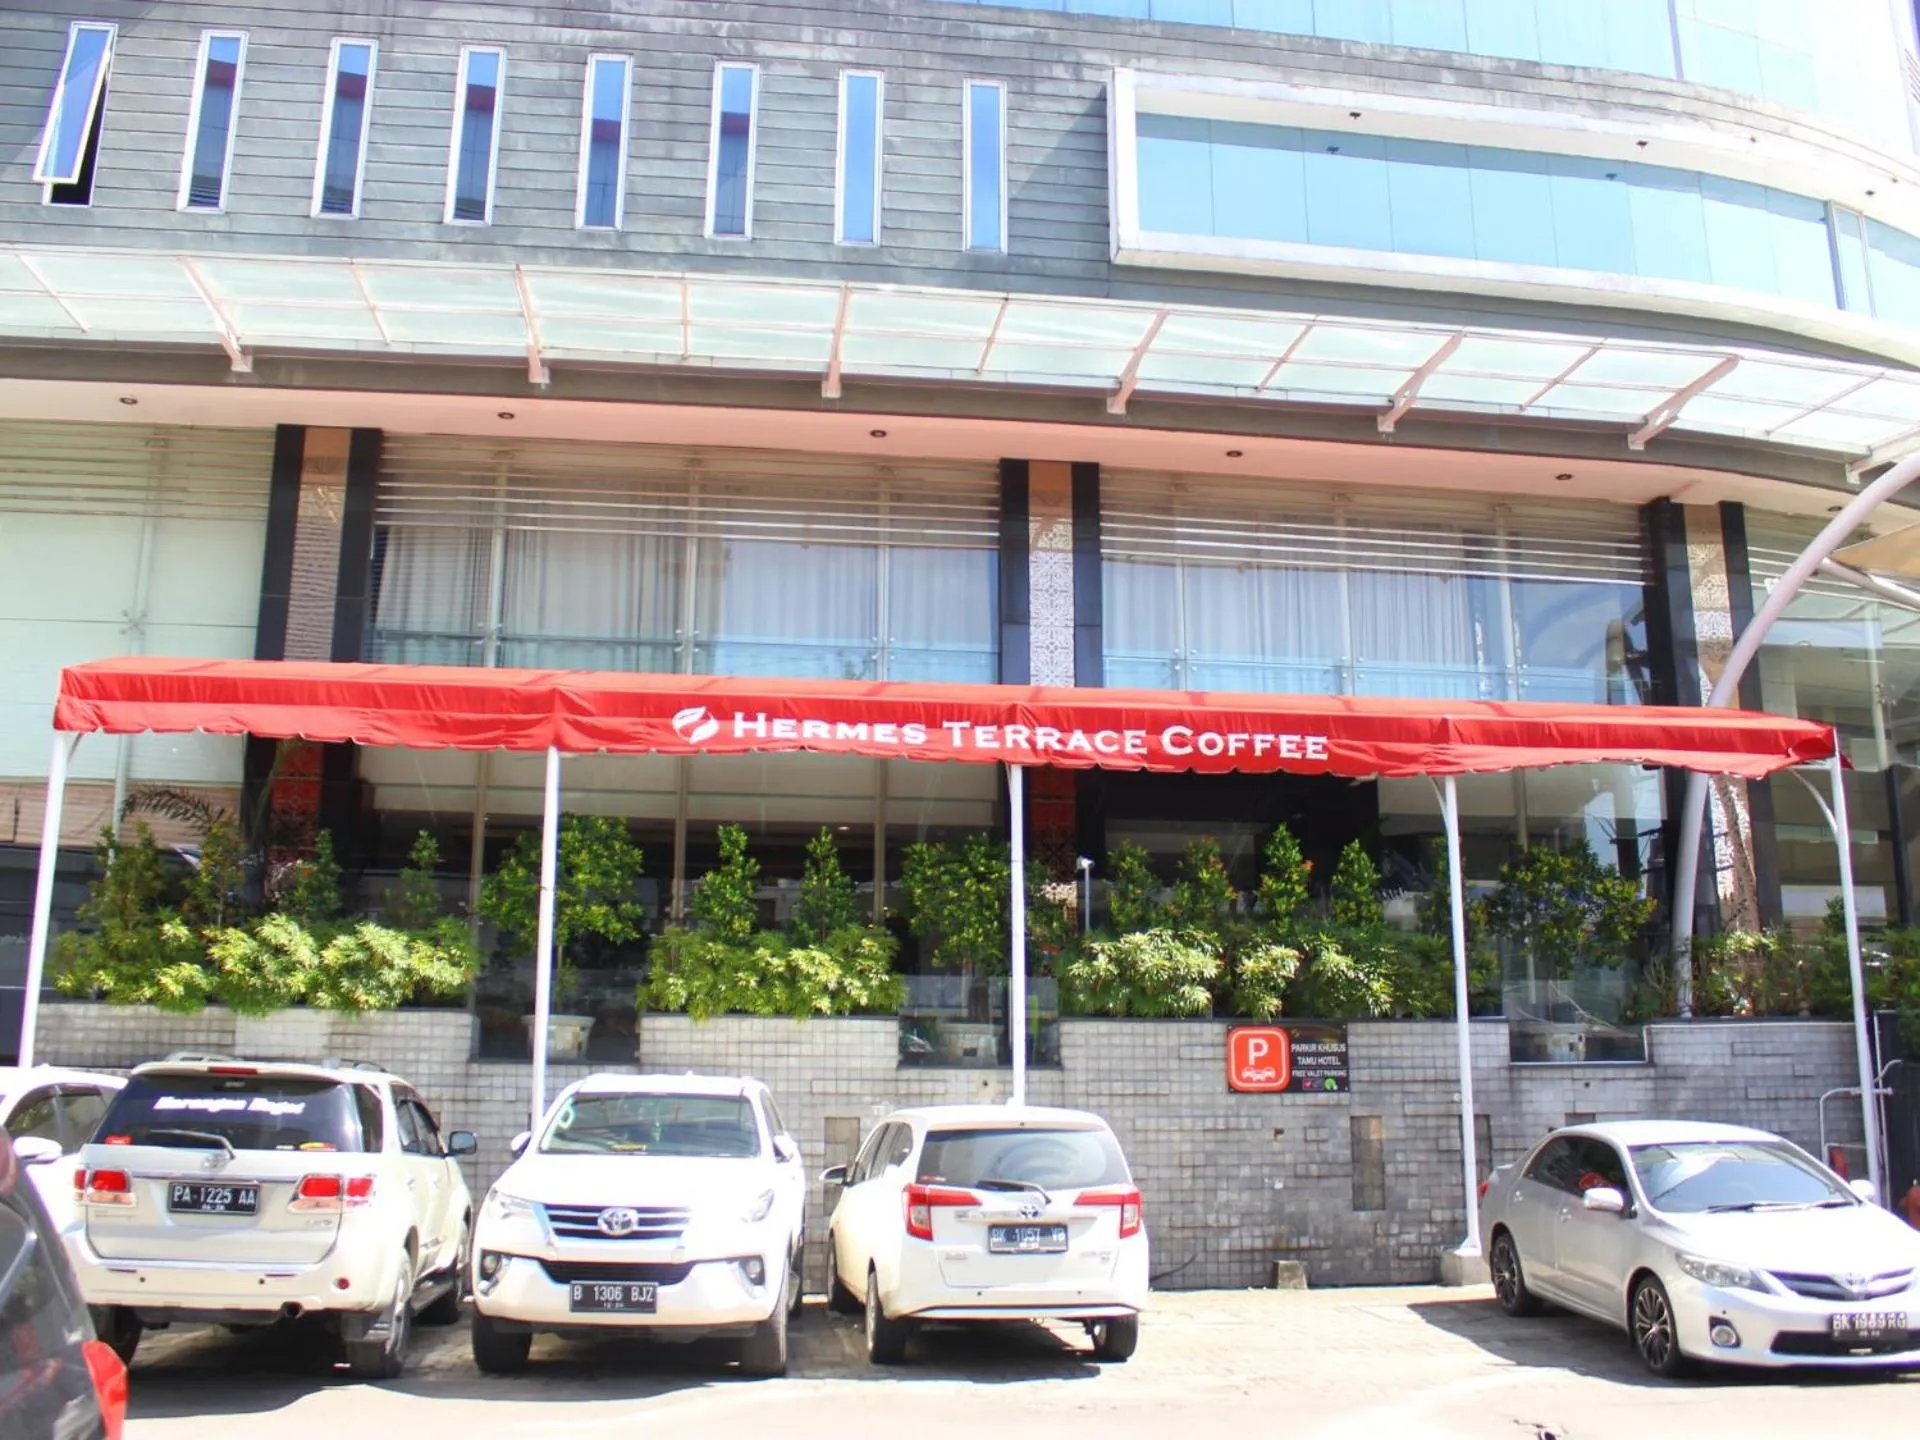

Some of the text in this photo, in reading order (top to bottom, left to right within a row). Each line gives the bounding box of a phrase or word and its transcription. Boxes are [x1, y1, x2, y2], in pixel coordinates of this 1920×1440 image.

[732, 711, 1329, 760] HERMES TERRACE COFFEE
[1248, 1038, 1269, 1065] P
[1318, 1043, 1346, 1052] KHUSUS
[1297, 1056, 1341, 1065] TAMU HOTEL
[173, 1186, 255, 1205] PA 1225 AA
[573, 1285, 654, 1302] B 1306 BJZ
